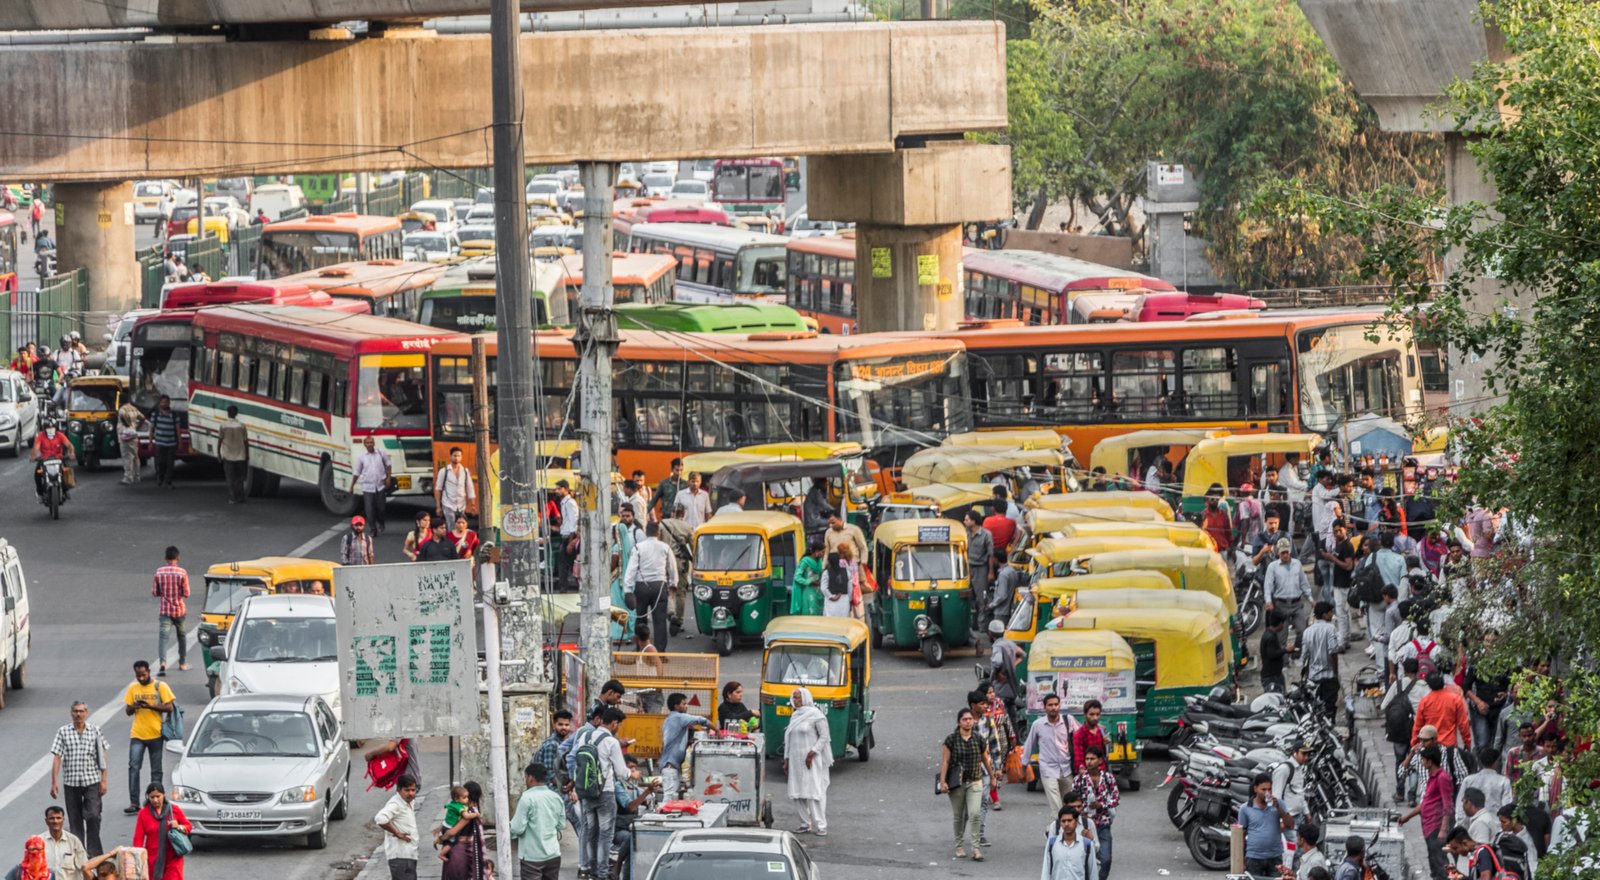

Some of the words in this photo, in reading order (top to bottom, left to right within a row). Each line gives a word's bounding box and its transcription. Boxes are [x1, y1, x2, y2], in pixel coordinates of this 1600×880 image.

[1054, 658, 1071, 667] फेना
[1074, 658, 1083, 667] ही
[1086, 658, 1105, 667] लेना
